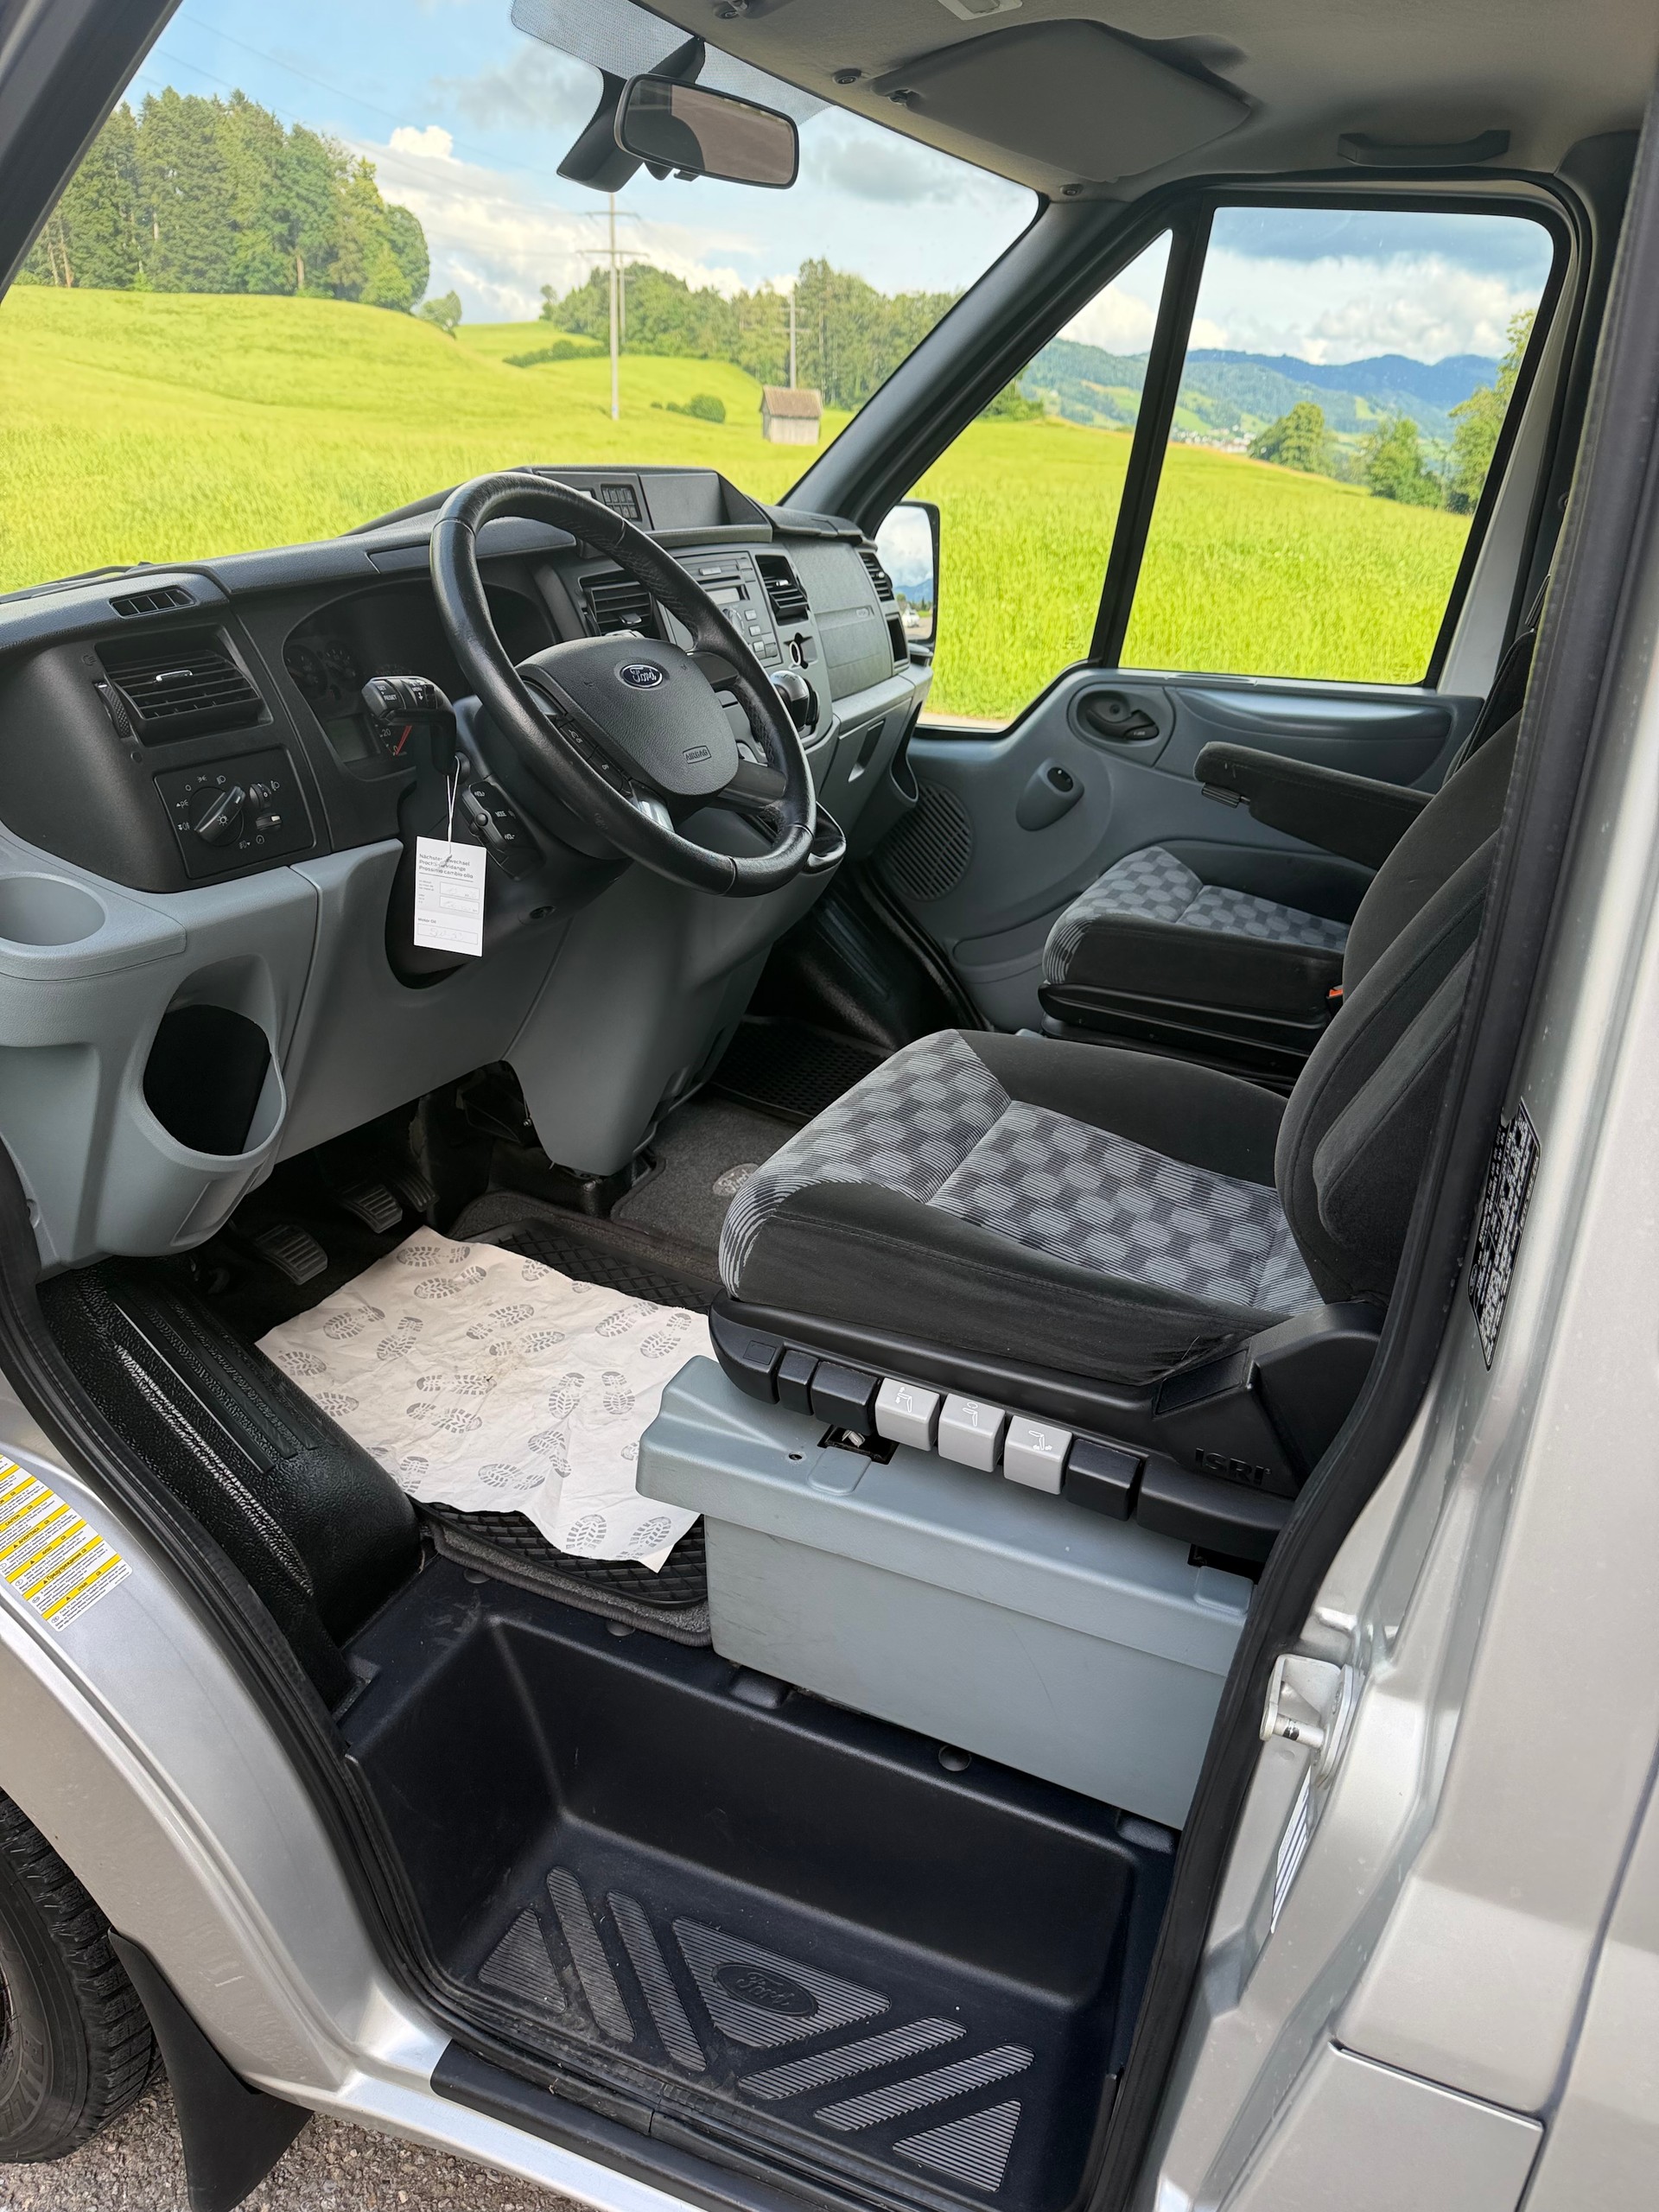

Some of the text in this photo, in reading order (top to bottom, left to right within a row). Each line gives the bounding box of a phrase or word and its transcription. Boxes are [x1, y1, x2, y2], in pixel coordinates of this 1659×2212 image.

[629, 666, 658, 683] Ford
[684, 748, 709, 761] AIRBAG
[736, 1971, 795, 2006] Ford
